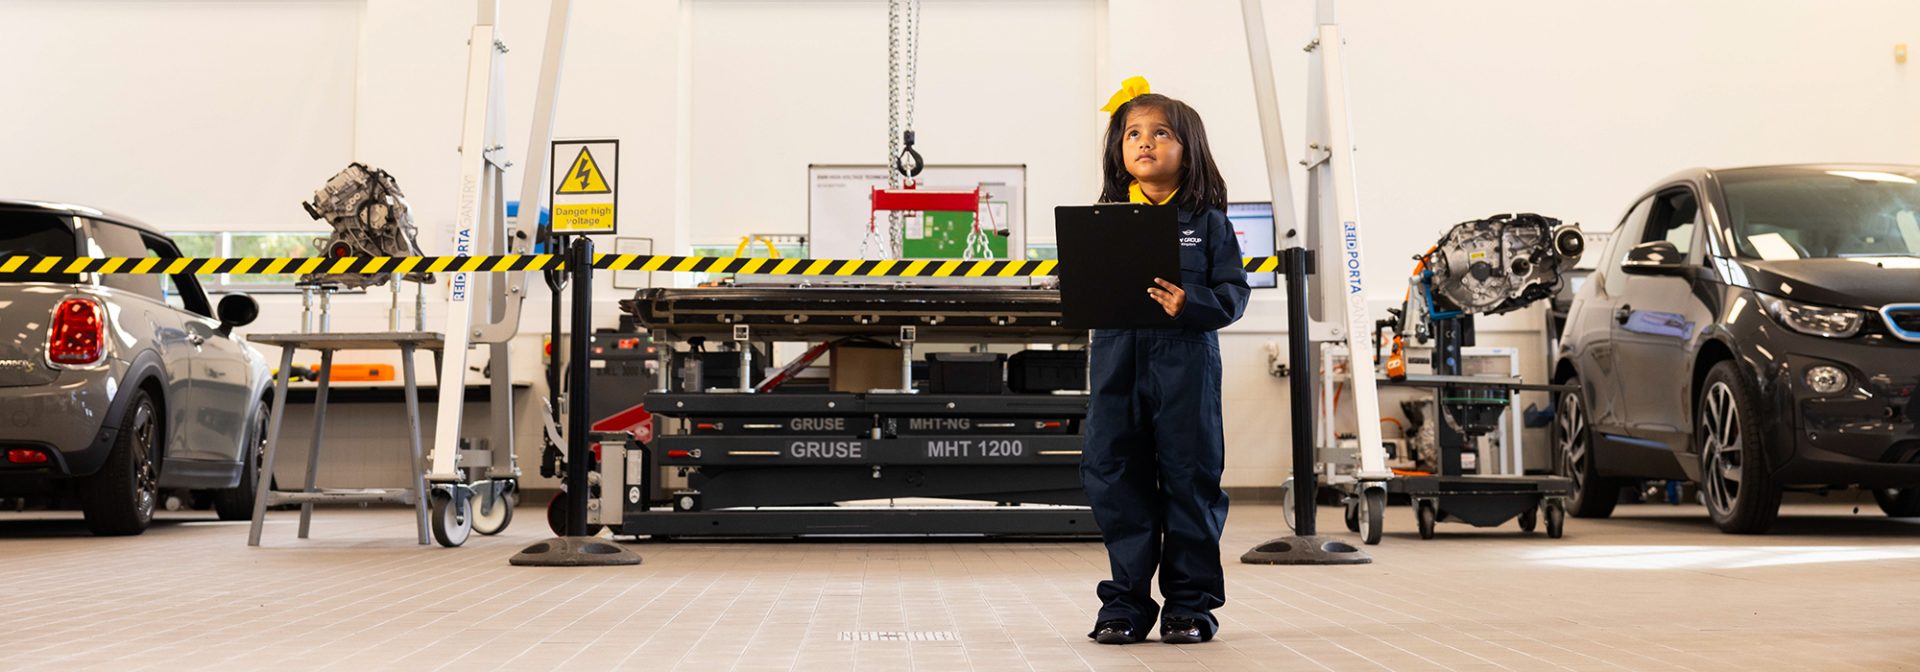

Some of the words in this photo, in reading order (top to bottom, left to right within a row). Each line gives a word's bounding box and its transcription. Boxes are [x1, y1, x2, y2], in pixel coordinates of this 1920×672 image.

[556, 207, 588, 217] Danger
[591, 207, 612, 217] high
[566, 217, 600, 226] voltage
[457, 229, 471, 257] RTA
[1344, 221, 1357, 250] REID
[453, 272, 467, 301] REID
[790, 418, 845, 431] GRUSE
[910, 418, 970, 430] MHT-NG
[791, 441, 862, 458] GRUSE
[928, 441, 972, 457] MHT
[978, 440, 1023, 457] 1200
